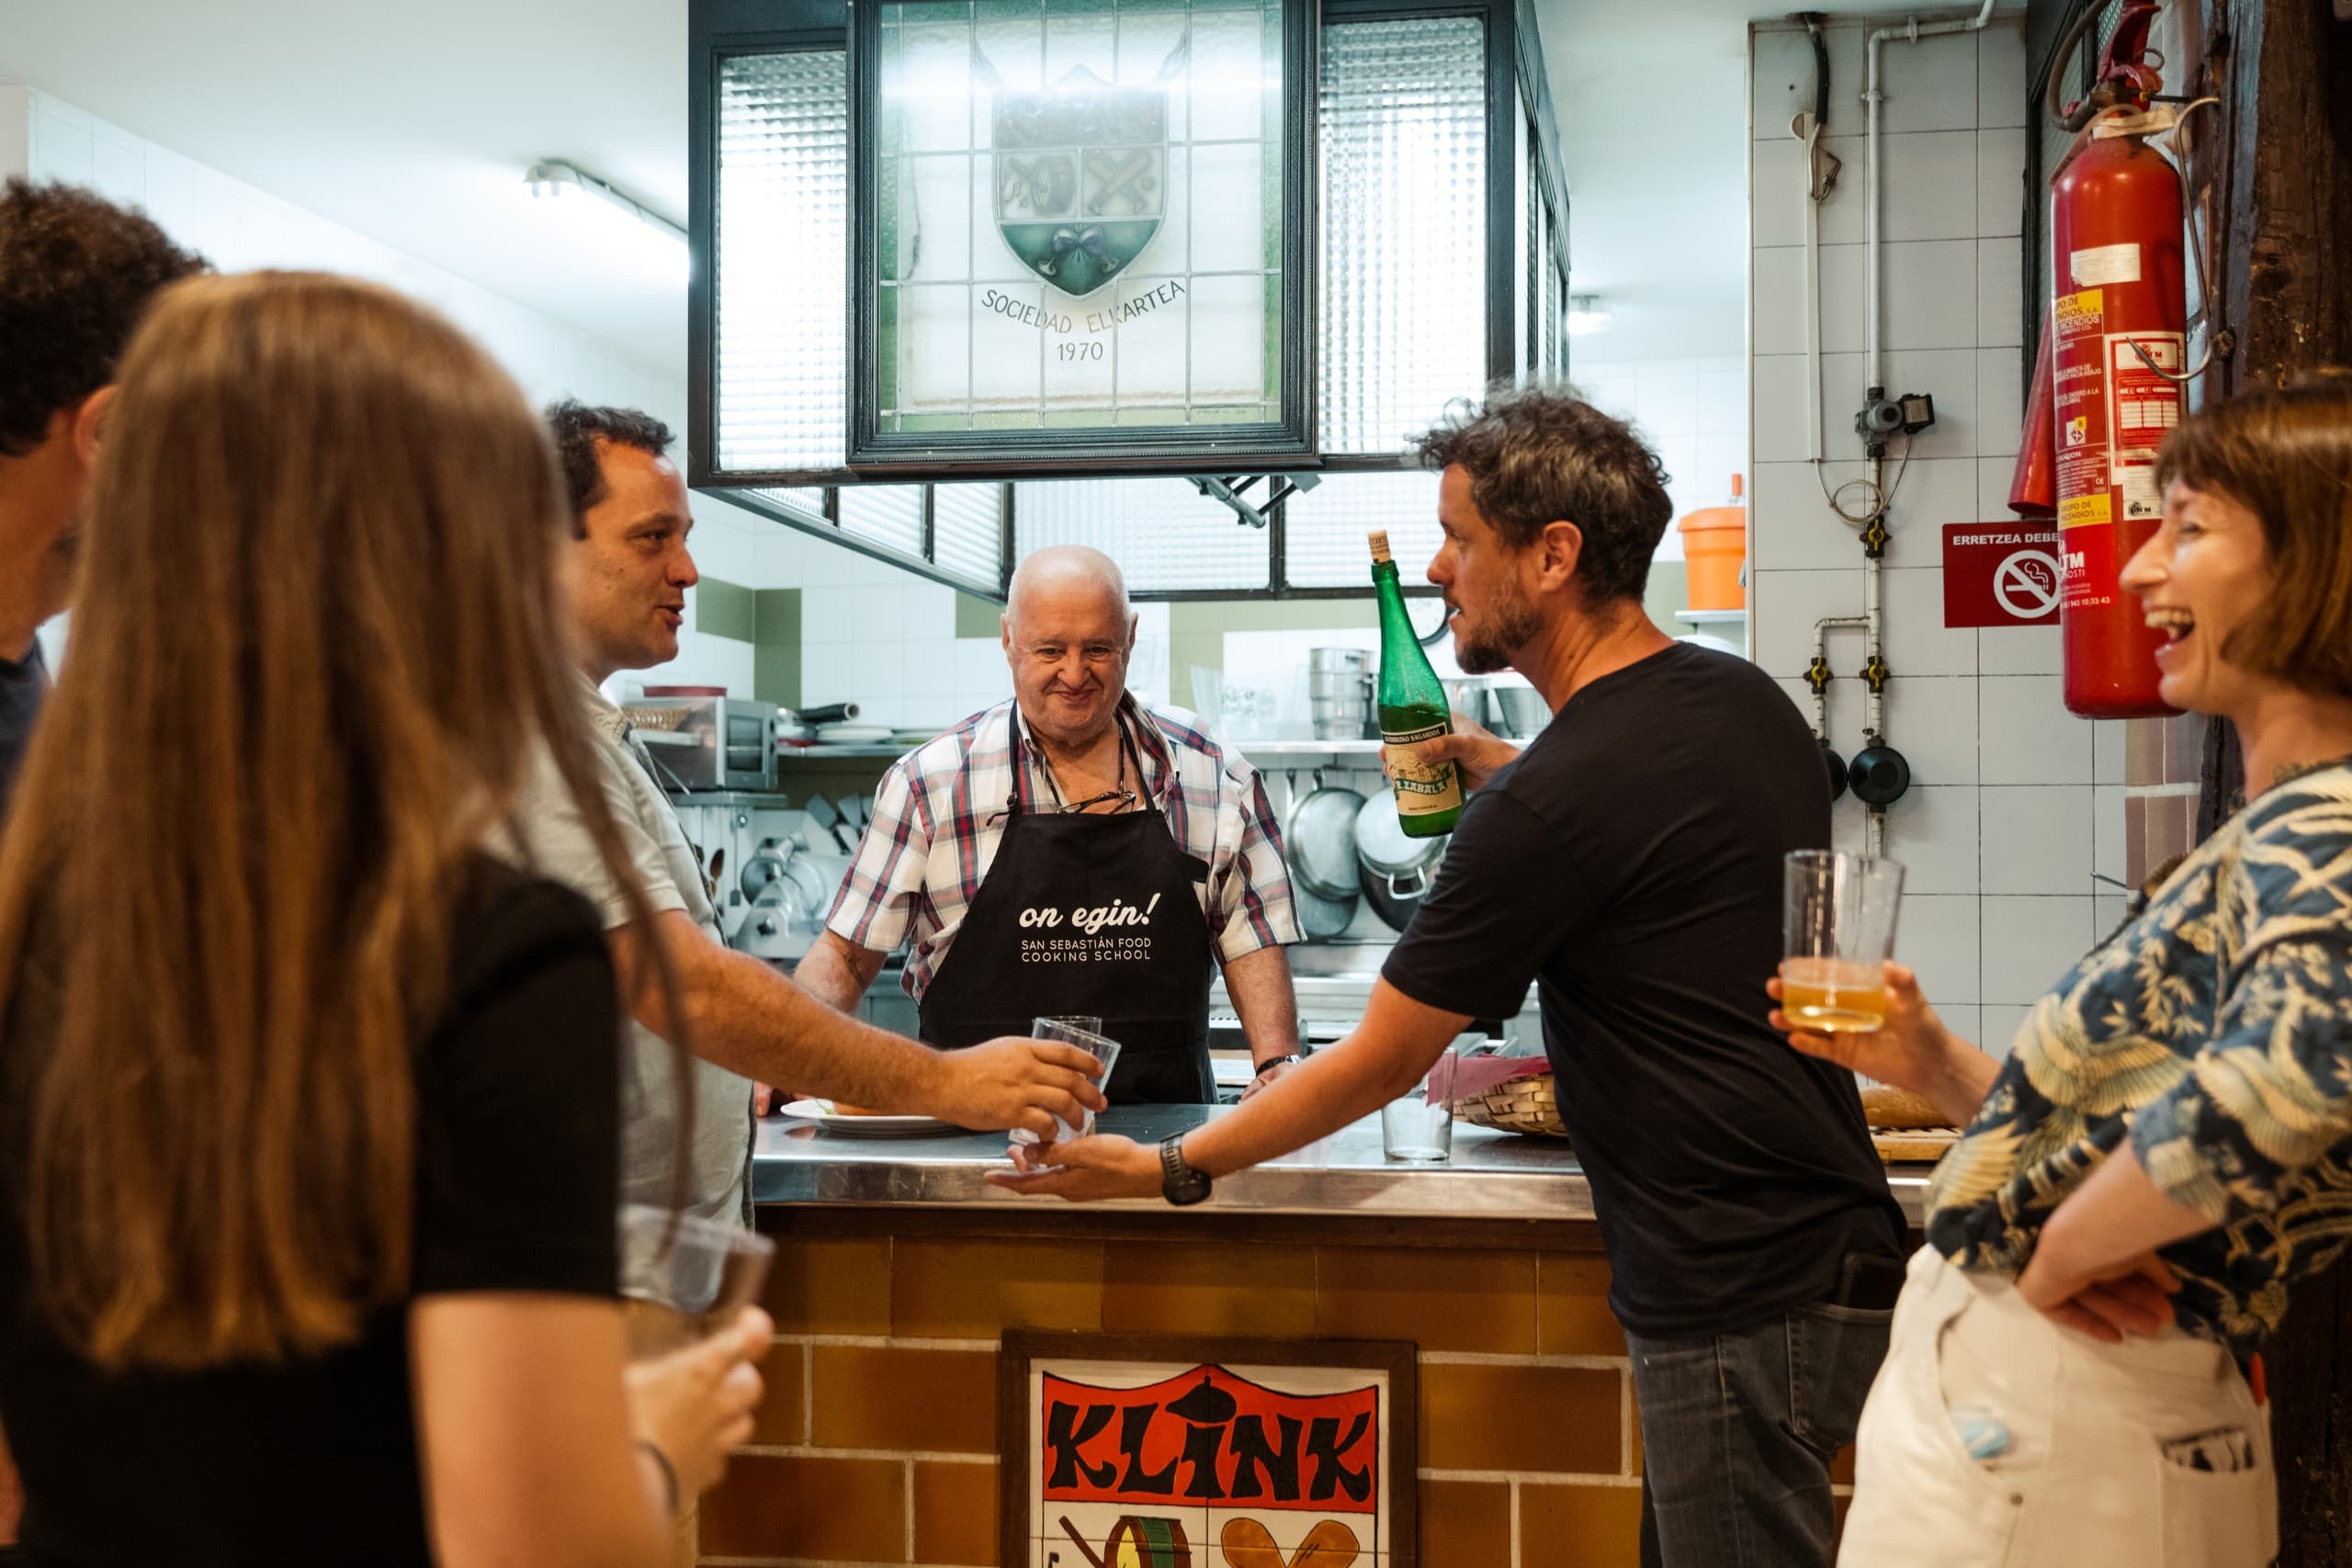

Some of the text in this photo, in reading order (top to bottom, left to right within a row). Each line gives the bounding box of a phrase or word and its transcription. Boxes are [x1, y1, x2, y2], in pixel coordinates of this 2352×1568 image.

[981, 279, 1186, 334] SOCIEDAD ELKARTEA
[1057, 341, 1104, 362] 1970
[1952, 534, 2021, 546] ERRETZEA
[1404, 781, 1446, 795] ZABALA
[1019, 892, 1161, 935] on egin!
[1022, 936, 1151, 950] SAN SEBASTIÁN FOOD
[1022, 950, 1150, 963] COOKING SCHOOL
